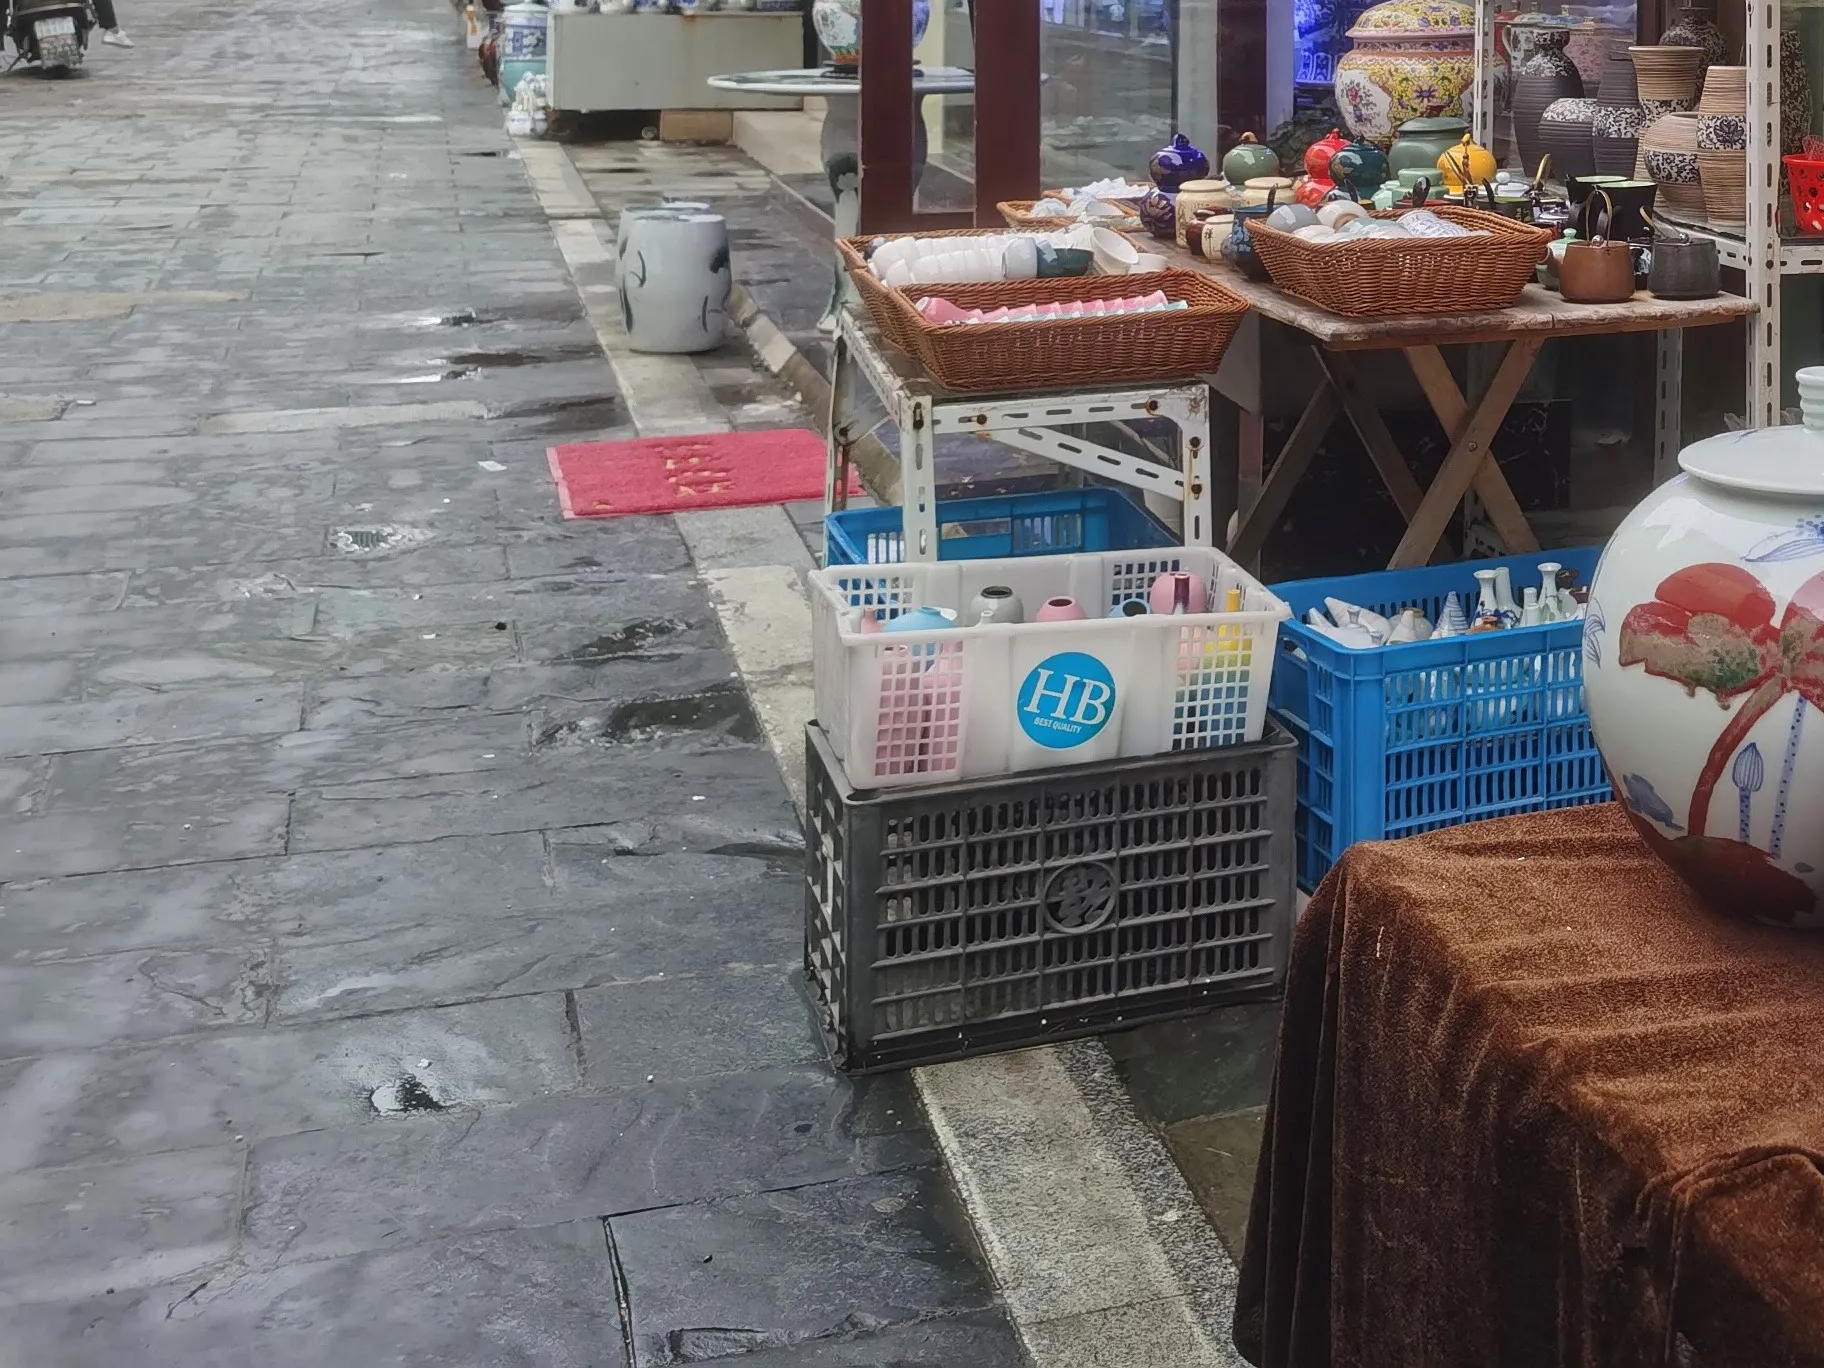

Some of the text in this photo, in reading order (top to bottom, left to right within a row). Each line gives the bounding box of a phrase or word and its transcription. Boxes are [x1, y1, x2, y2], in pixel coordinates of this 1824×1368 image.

[1023, 668, 1111, 725] HB
[1033, 717, 1082, 733] BEST QUALITY
